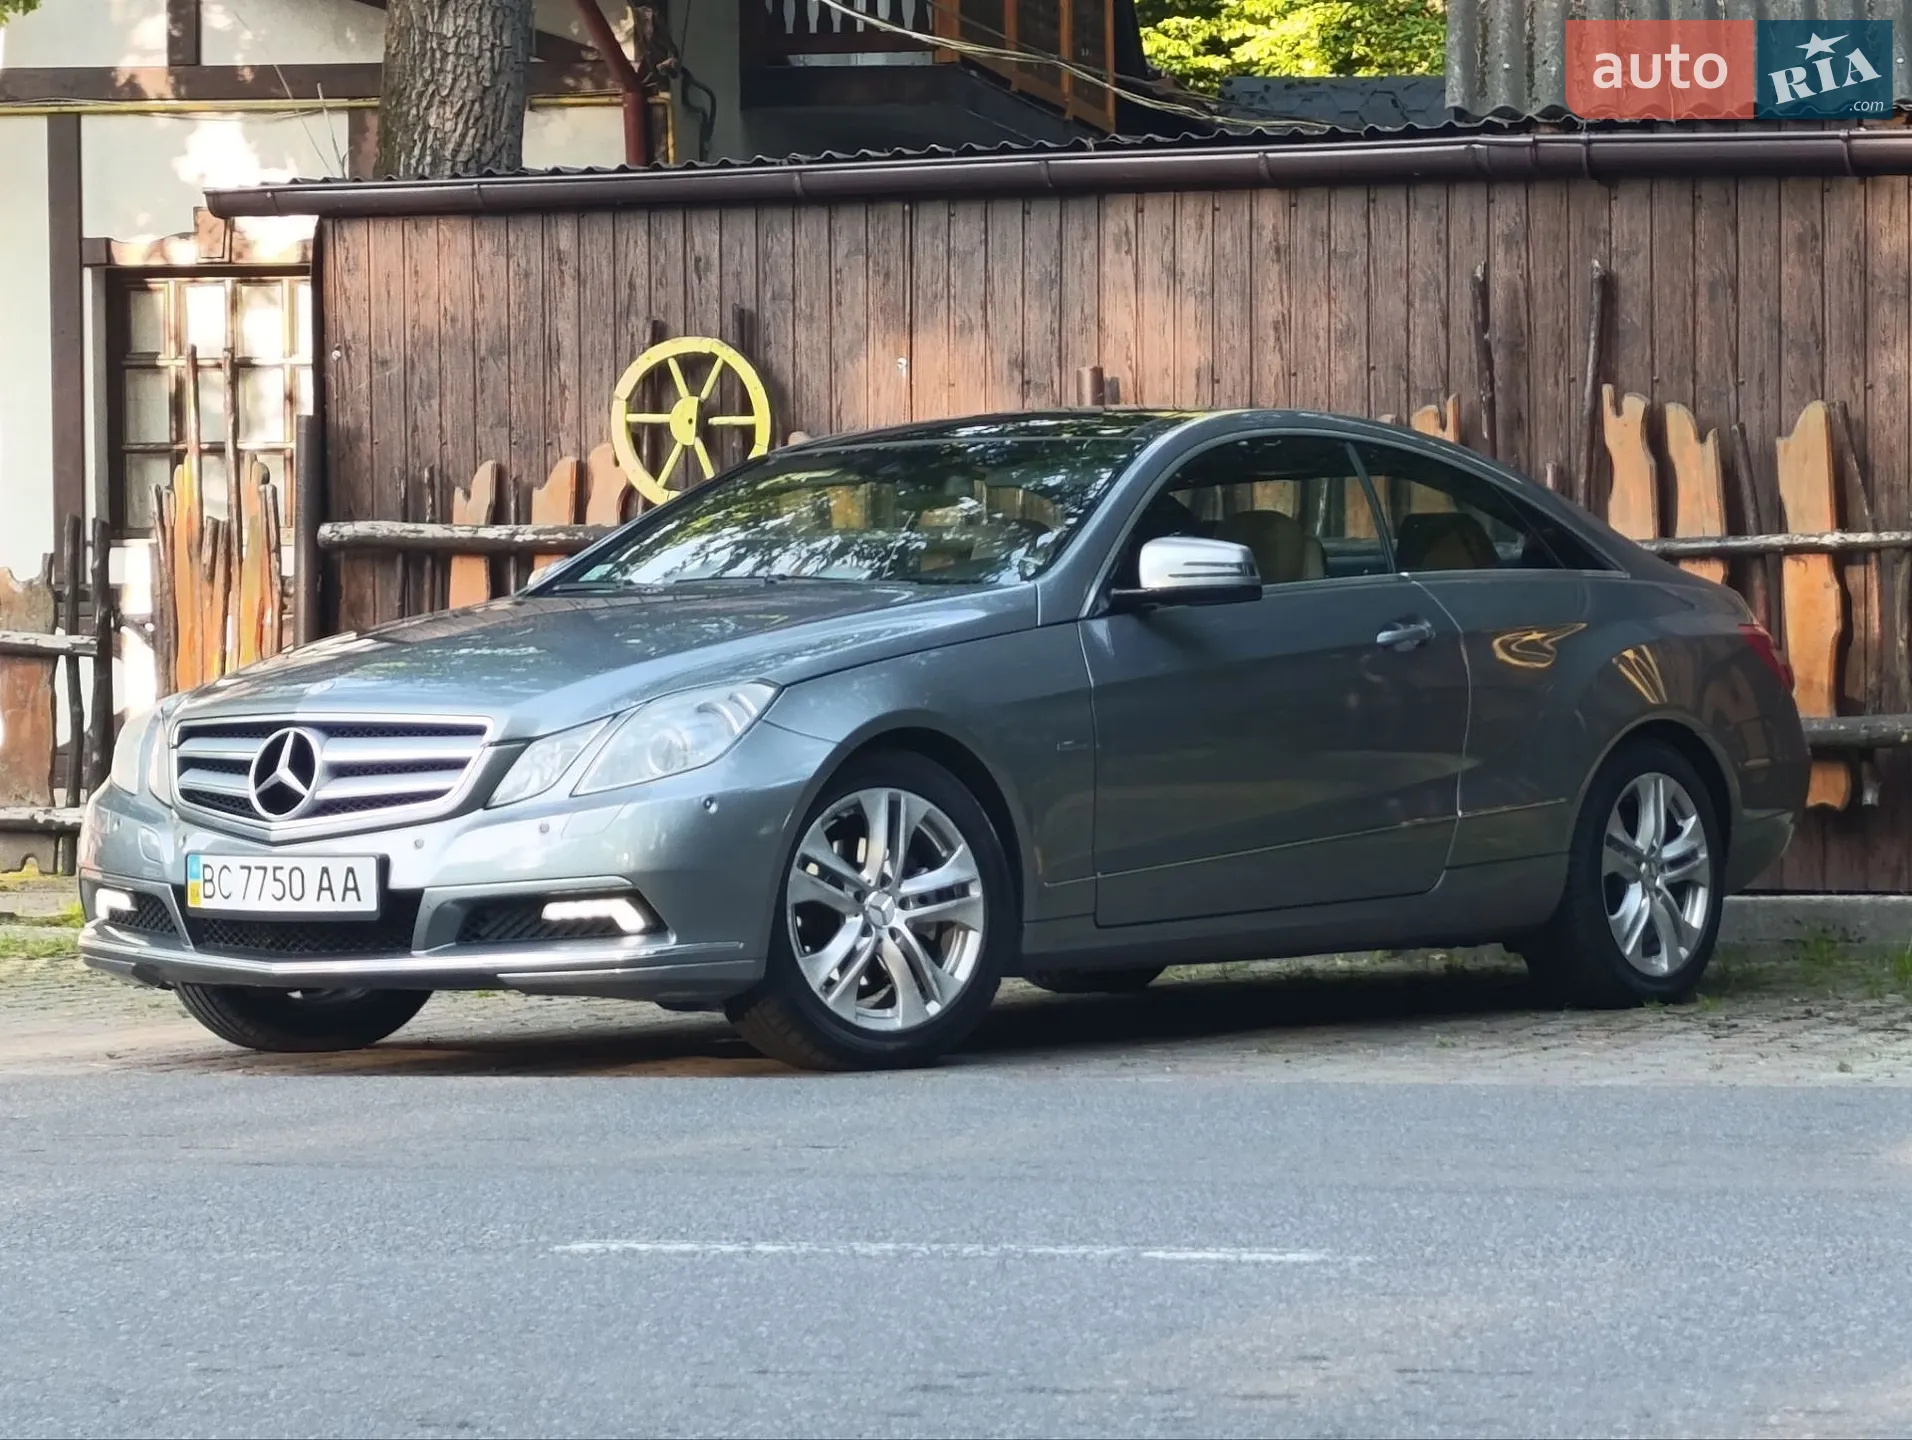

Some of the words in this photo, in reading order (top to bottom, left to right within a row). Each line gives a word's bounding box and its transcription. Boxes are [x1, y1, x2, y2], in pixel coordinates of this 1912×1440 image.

[202, 864, 232, 899] BC
[239, 865, 305, 901] 7750
[316, 866, 362, 902] AA
